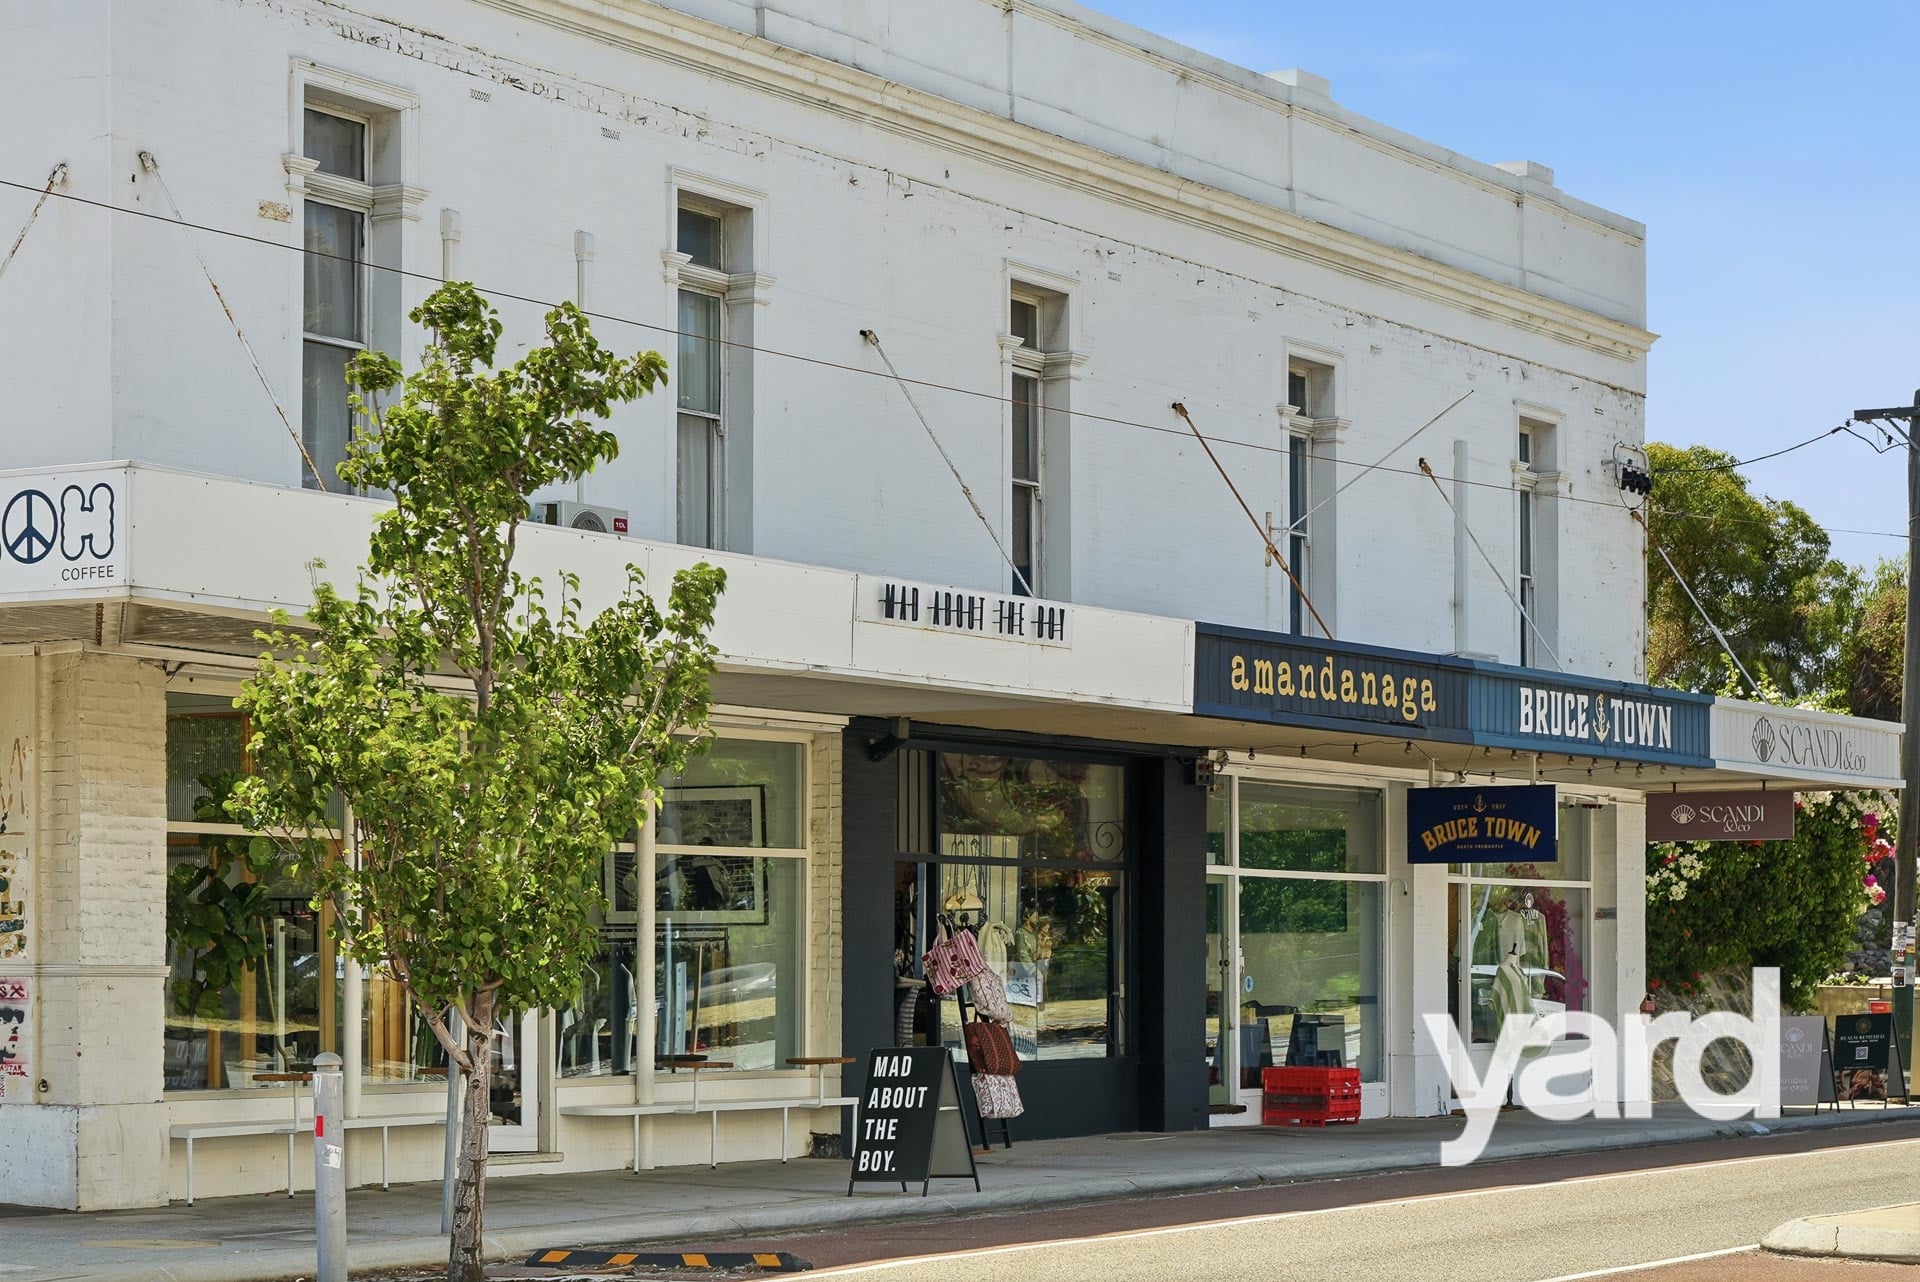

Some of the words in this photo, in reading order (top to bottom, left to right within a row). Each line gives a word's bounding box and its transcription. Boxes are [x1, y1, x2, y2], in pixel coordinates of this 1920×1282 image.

[615, 521, 626, 529] TCL
[61, 565, 115, 581] COFFEE
[881, 583, 919, 621] MAD
[930, 590, 985, 631] ABOUT
[995, 599, 1025, 636] THE
[1034, 605, 1065, 641] BOY
[1230, 655, 1437, 721] amandanaga
[1519, 687, 1589, 739] BRUCE
[1609, 698, 1672, 749] TOWN
[1699, 805, 1764, 824] SCANDI
[1421, 817, 1478, 852] BRUCE
[1484, 817, 1541, 850] TOWN
[1778, 1042, 1813, 1054] CANDI
[873, 1055, 912, 1078] MAD
[868, 1086, 928, 1109] ABOUT
[865, 1118, 898, 1141] THE
[858, 1150, 896, 1172] BOY.
